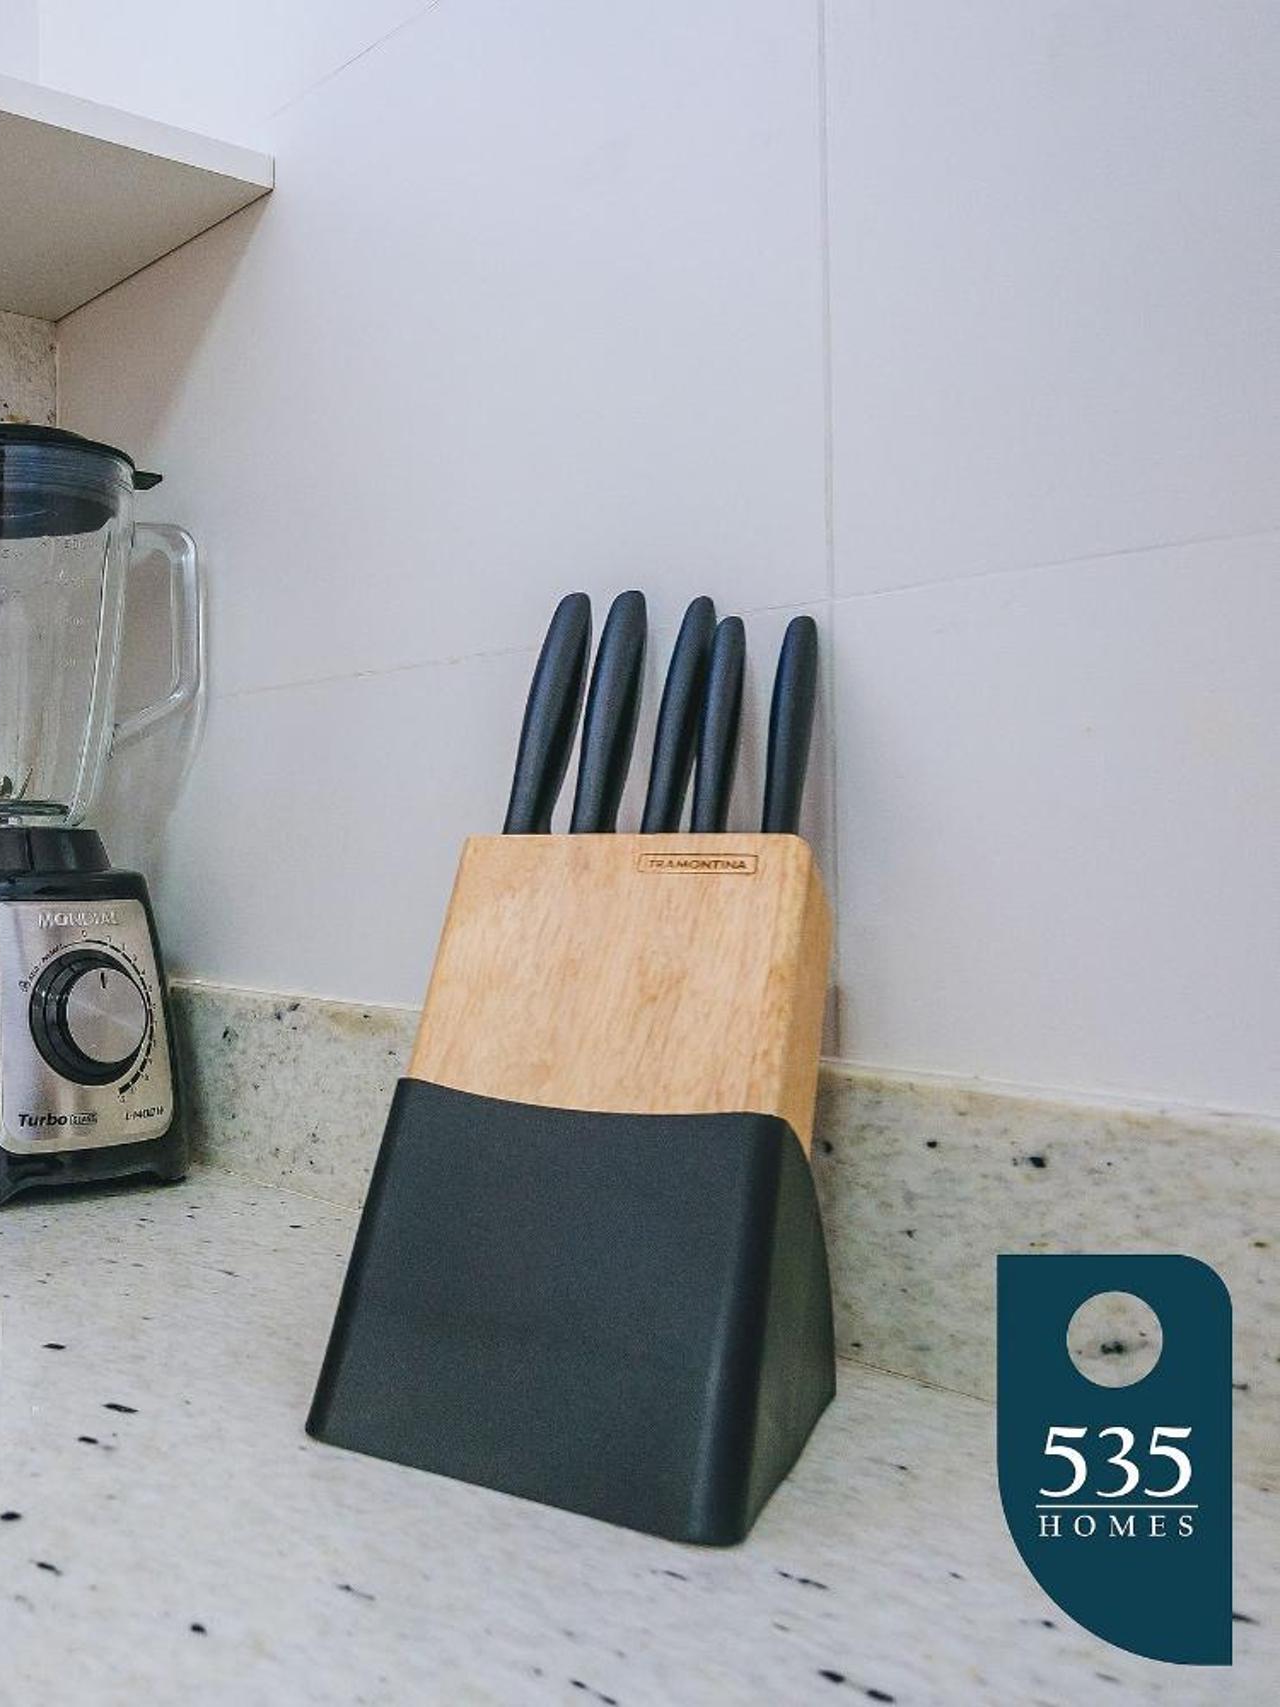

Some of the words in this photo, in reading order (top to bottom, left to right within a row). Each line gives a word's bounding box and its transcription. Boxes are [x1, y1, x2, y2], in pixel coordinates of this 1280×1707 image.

[649, 859, 748, 870] TRAMONTINA
[38, 911, 120, 928] MONDIAL
[18, 1113, 68, 1127] Turbo
